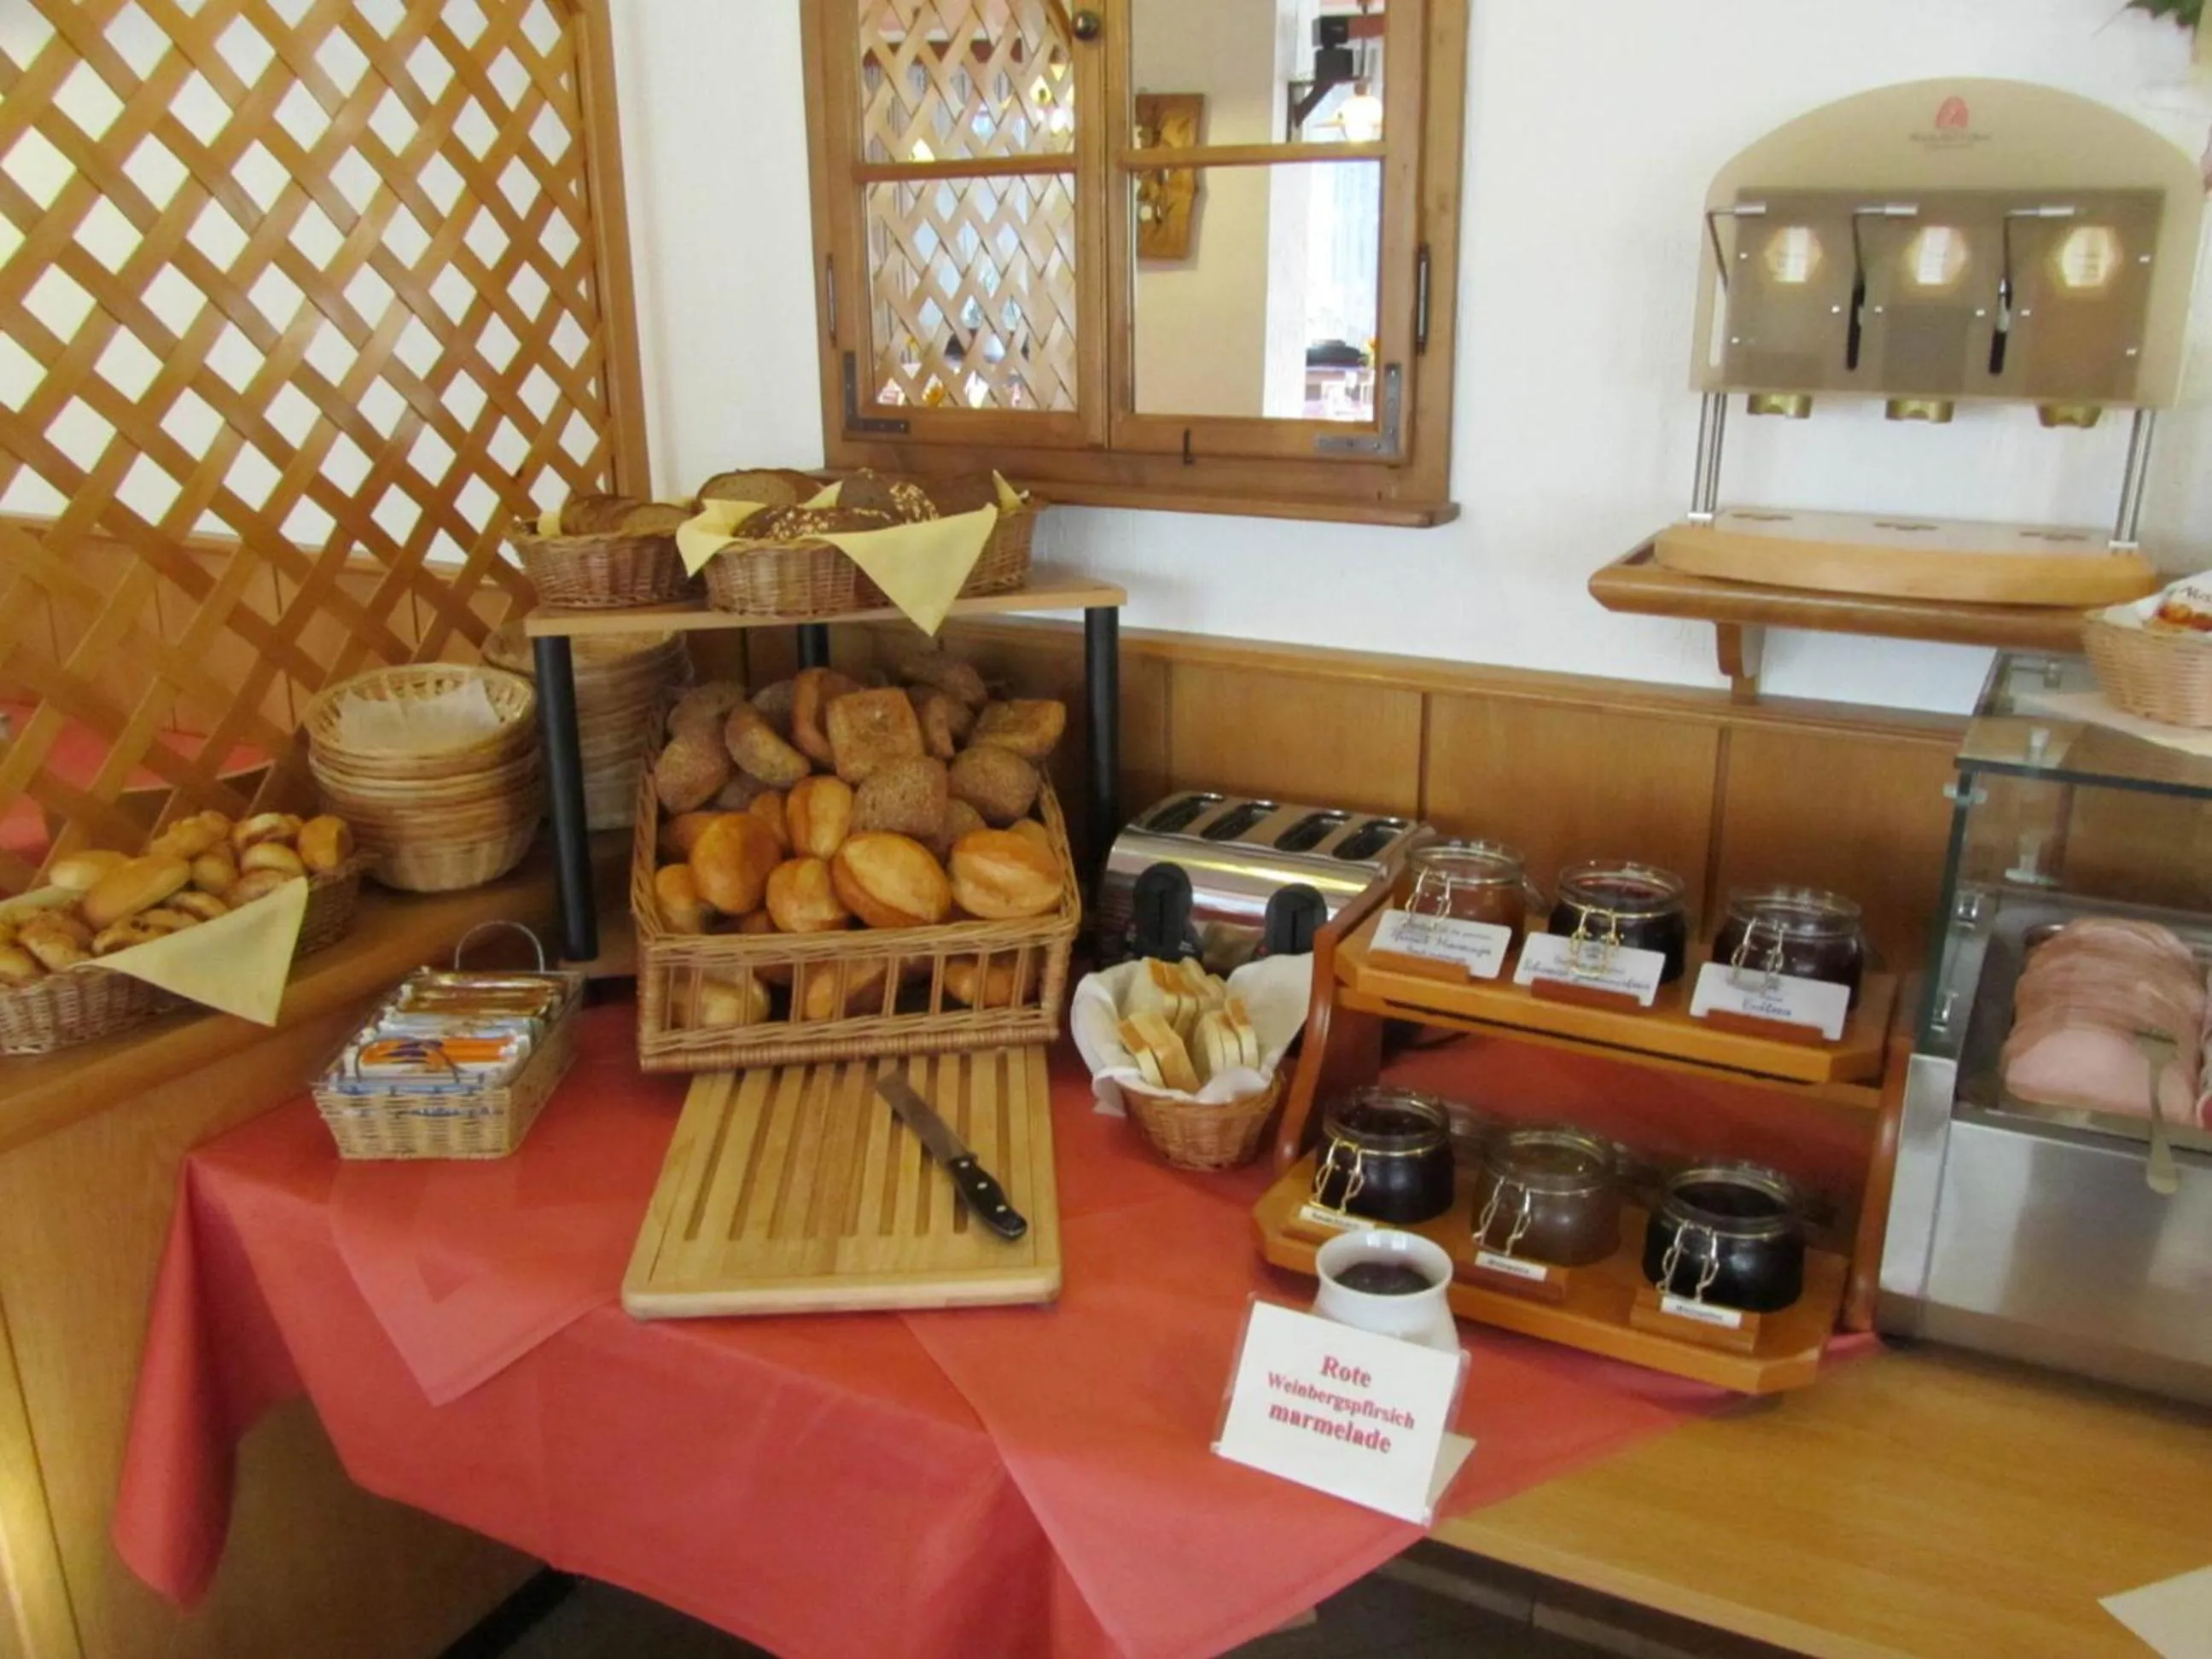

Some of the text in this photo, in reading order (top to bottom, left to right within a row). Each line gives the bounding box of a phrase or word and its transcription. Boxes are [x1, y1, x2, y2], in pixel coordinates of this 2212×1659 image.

[1320, 1355, 1371, 1388] Rote
[1268, 1371, 1415, 1429] Weinbergspfirsich
[1269, 1403, 1391, 1453] marmelade
